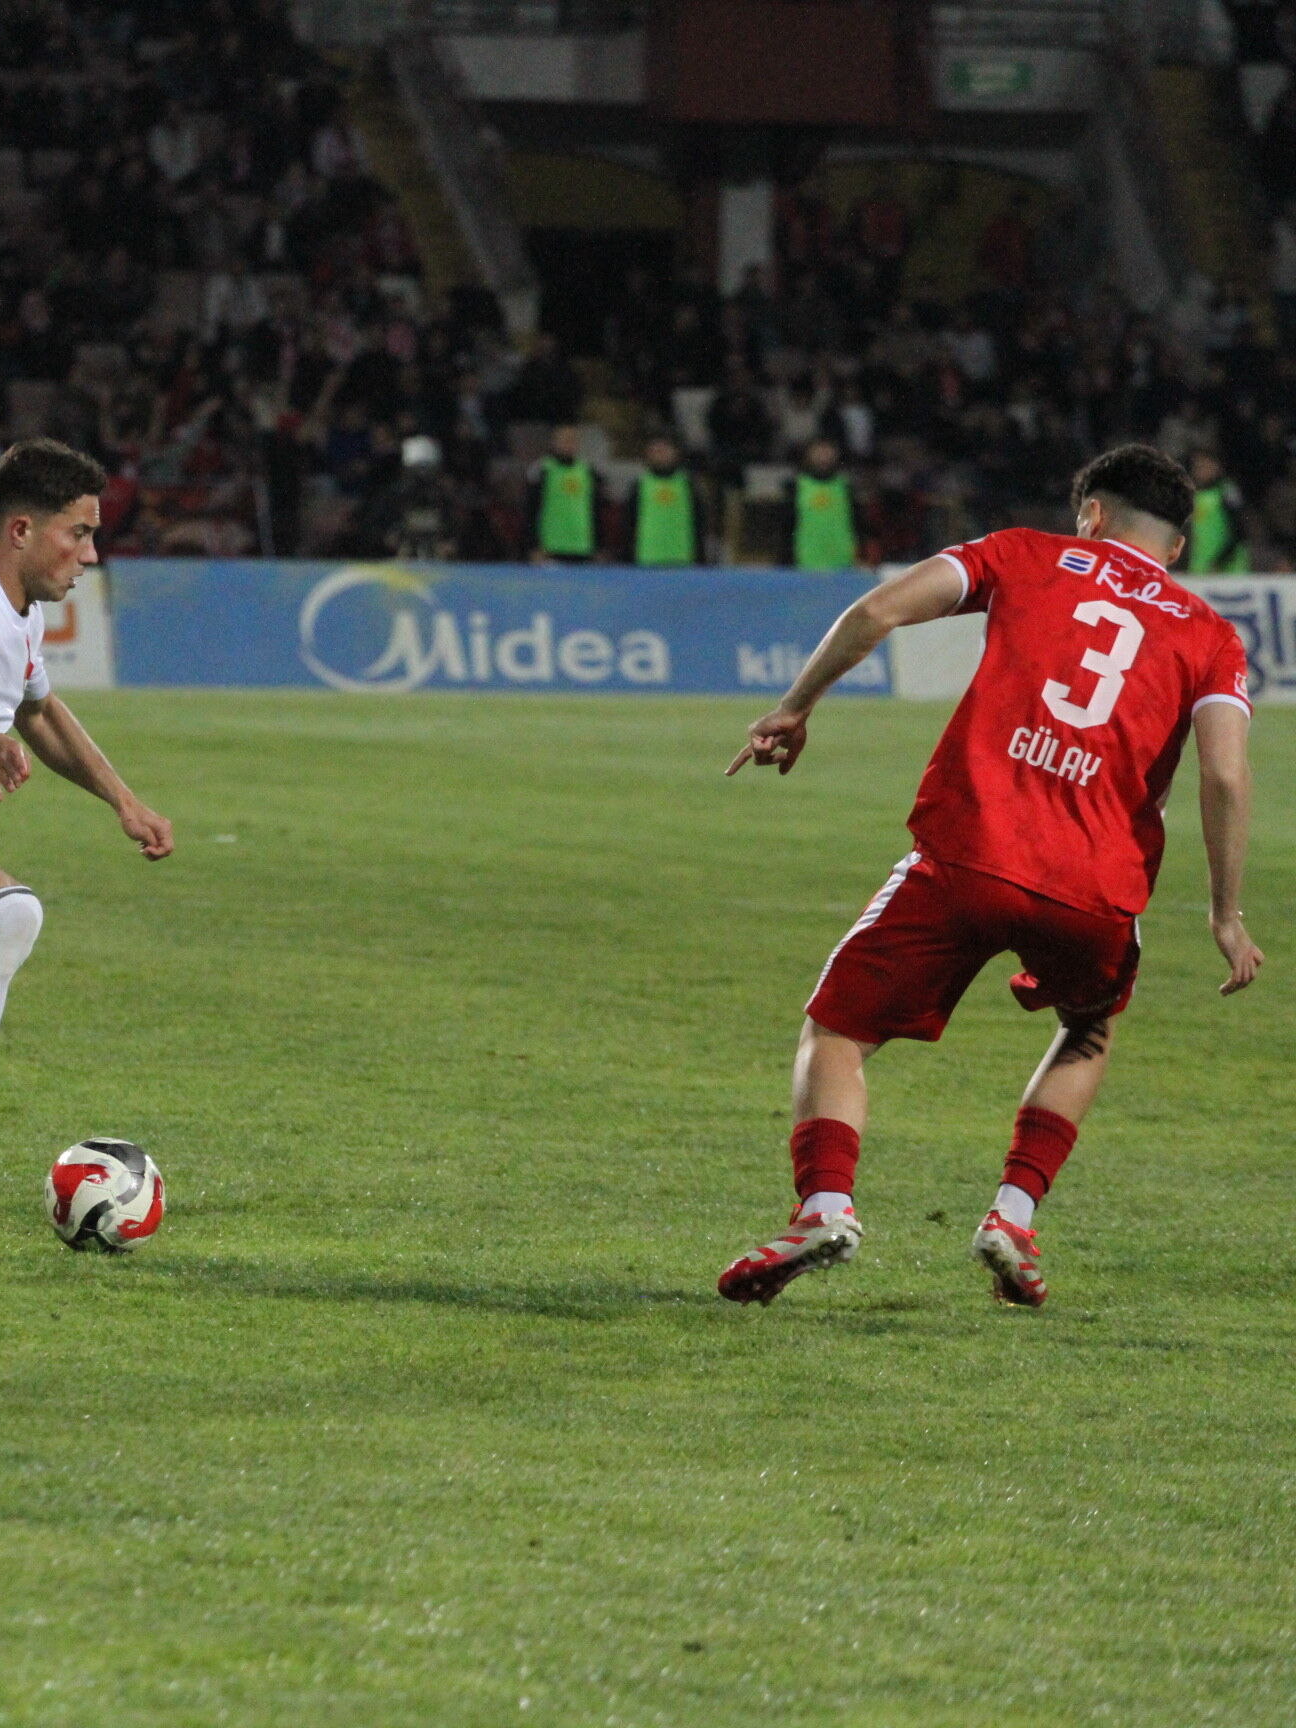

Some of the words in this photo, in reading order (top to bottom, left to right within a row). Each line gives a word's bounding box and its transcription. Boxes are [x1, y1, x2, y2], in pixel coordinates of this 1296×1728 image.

[359, 609, 670, 683] Midea
[737, 642, 888, 686] klia
[1041, 600, 1145, 729] 3
[1007, 726, 1102, 786] GÜLAY
